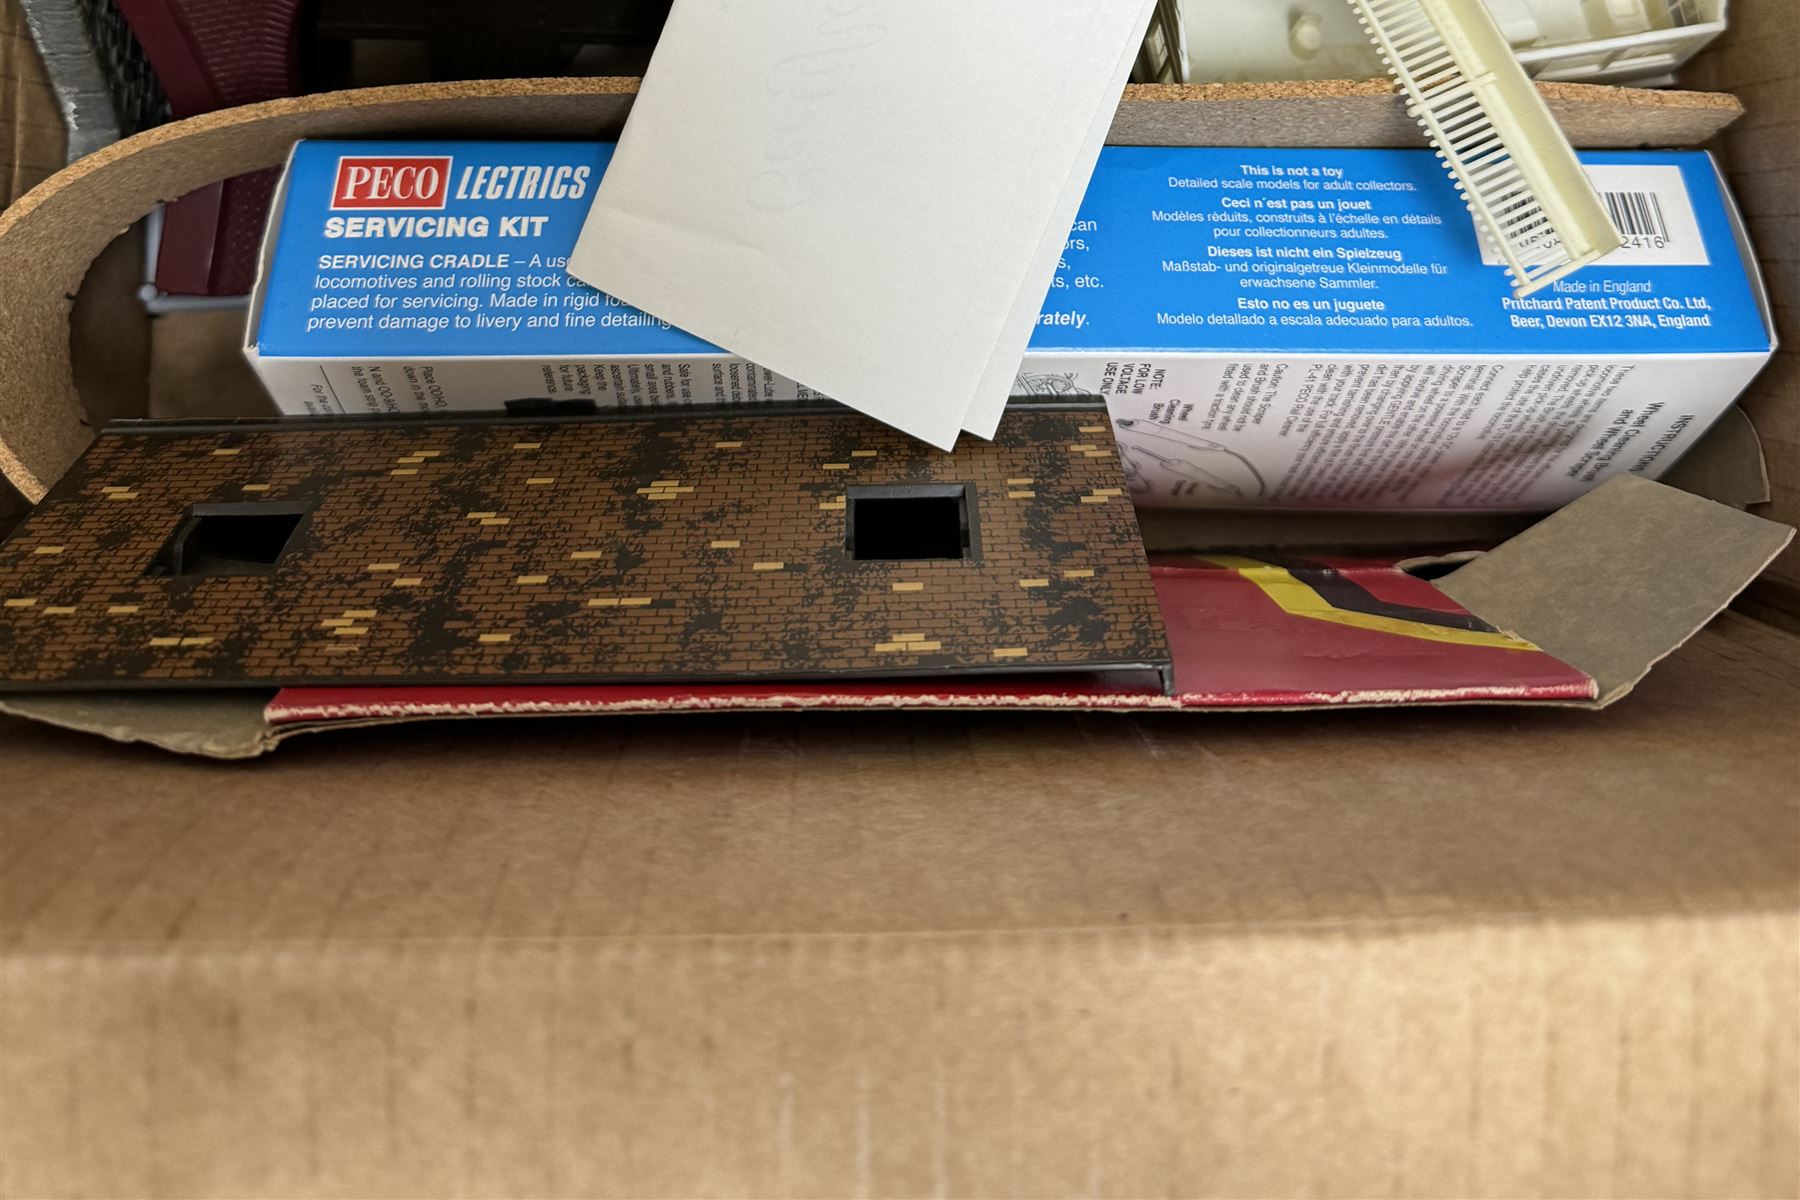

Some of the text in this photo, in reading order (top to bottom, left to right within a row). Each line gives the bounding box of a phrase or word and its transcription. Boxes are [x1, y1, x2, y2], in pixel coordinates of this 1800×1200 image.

[1241, 165, 1343, 178] This is not a toy
[342, 166, 590, 200] PECO LECTRICS
[1168, 177, 1417, 191] Detailed scale models for adult collectors.
[1222, 197, 1251, 208] Ceci
[1291, 200, 1314, 211] pas
[1318, 201, 1334, 209] un
[1338, 200, 1371, 211] jouet
[324, 216, 548, 238] SERVICING KIT
[1152, 211, 1204, 221] Modèles
[1208, 211, 1252, 223] réduits,
[1256, 212, 1314, 223] construits
[1319, 213, 1326, 223] à
[1402, 214, 1442, 225] détails
[1214, 228, 1389, 239] pour collectionneurs adultes.
[319, 254, 424, 269] SERVICING
[429, 254, 509, 269] CRADLE
[529, 254, 541, 268] A
[1208, 246, 1402, 261] Dieses ist nicht ein Spielzeug
[1162, 261, 1447, 275] Maßstab- und originalgetreue Kleinmodelle für
[315, 273, 417, 288] locomotives
[423, 273, 455, 288] and
[460, 273, 511, 292] rolling
[516, 273, 560, 288] stock
[1075, 275, 1104, 287] etc.
[1240, 277, 1378, 288] erwachsene Sammler.
[1553, 280, 1651, 295] Made in England
[311, 293, 369, 311] placed
[375, 293, 397, 308] for
[402, 293, 483, 311] servicing.
[489, 293, 538, 308] Made
[544, 293, 557, 307] in
[564, 293, 599, 311] rigid
[1238, 298, 1385, 312] Esto no es un juguete
[1502, 297, 1712, 311] Pritchard Patent Product Co. Ltd,
[307, 314, 373, 332] prevent
[379, 313, 448, 332] damage
[455, 314, 470, 328] to
[476, 313, 521, 331] livery
[527, 313, 559, 328] and
[564, 312, 595, 327] fine
[1157, 313, 1473, 328] Modelo detallado a escala adecuado para adultos.
[1510, 315, 1711, 329] Beer, Devon EX12 3NA, England
[404, 366, 418, 383] down
[421, 366, 435, 383] Place
[575, 365, 594, 394] packaging
[593, 365, 609, 380] Keep
[679, 364, 691, 377] Safe
[1098, 362, 1118, 395] USE ONLY
[1115, 363, 1135, 394] VOLTAGE
[1132, 363, 1151, 394] FOR LOW
[1149, 369, 1166, 390] NOTE:
[1218, 363, 1238, 392] fitted with
[1248, 364, 1270, 394] and Brush
[1349, 364, 1370, 388] prevent
[1430, 364, 1453, 386] driving
[1447, 364, 1471, 390] Scraper
[1477, 364, 1502, 391] Connect
[1532, 364, 1550, 384] cases
[1609, 364, 1635, 384] These
[559, 374, 575, 391] future
[1228, 364, 1251, 403] used clean
[1251, 364, 1288, 424] Caution: The Scraper
[1294, 384, 1314, 403] PECO
[1148, 403, 1165, 420] Brush
[1159, 399, 1180, 424] Cleaning
[1178, 403, 1195, 421] Wheel
[1377, 400, 1402, 424] GENTLE
[1591, 409, 1634, 449] and Wheel
[1598, 401, 1664, 461] Wheel Cleaning
[1628, 415, 1695, 472] INSTRUCTIONS
